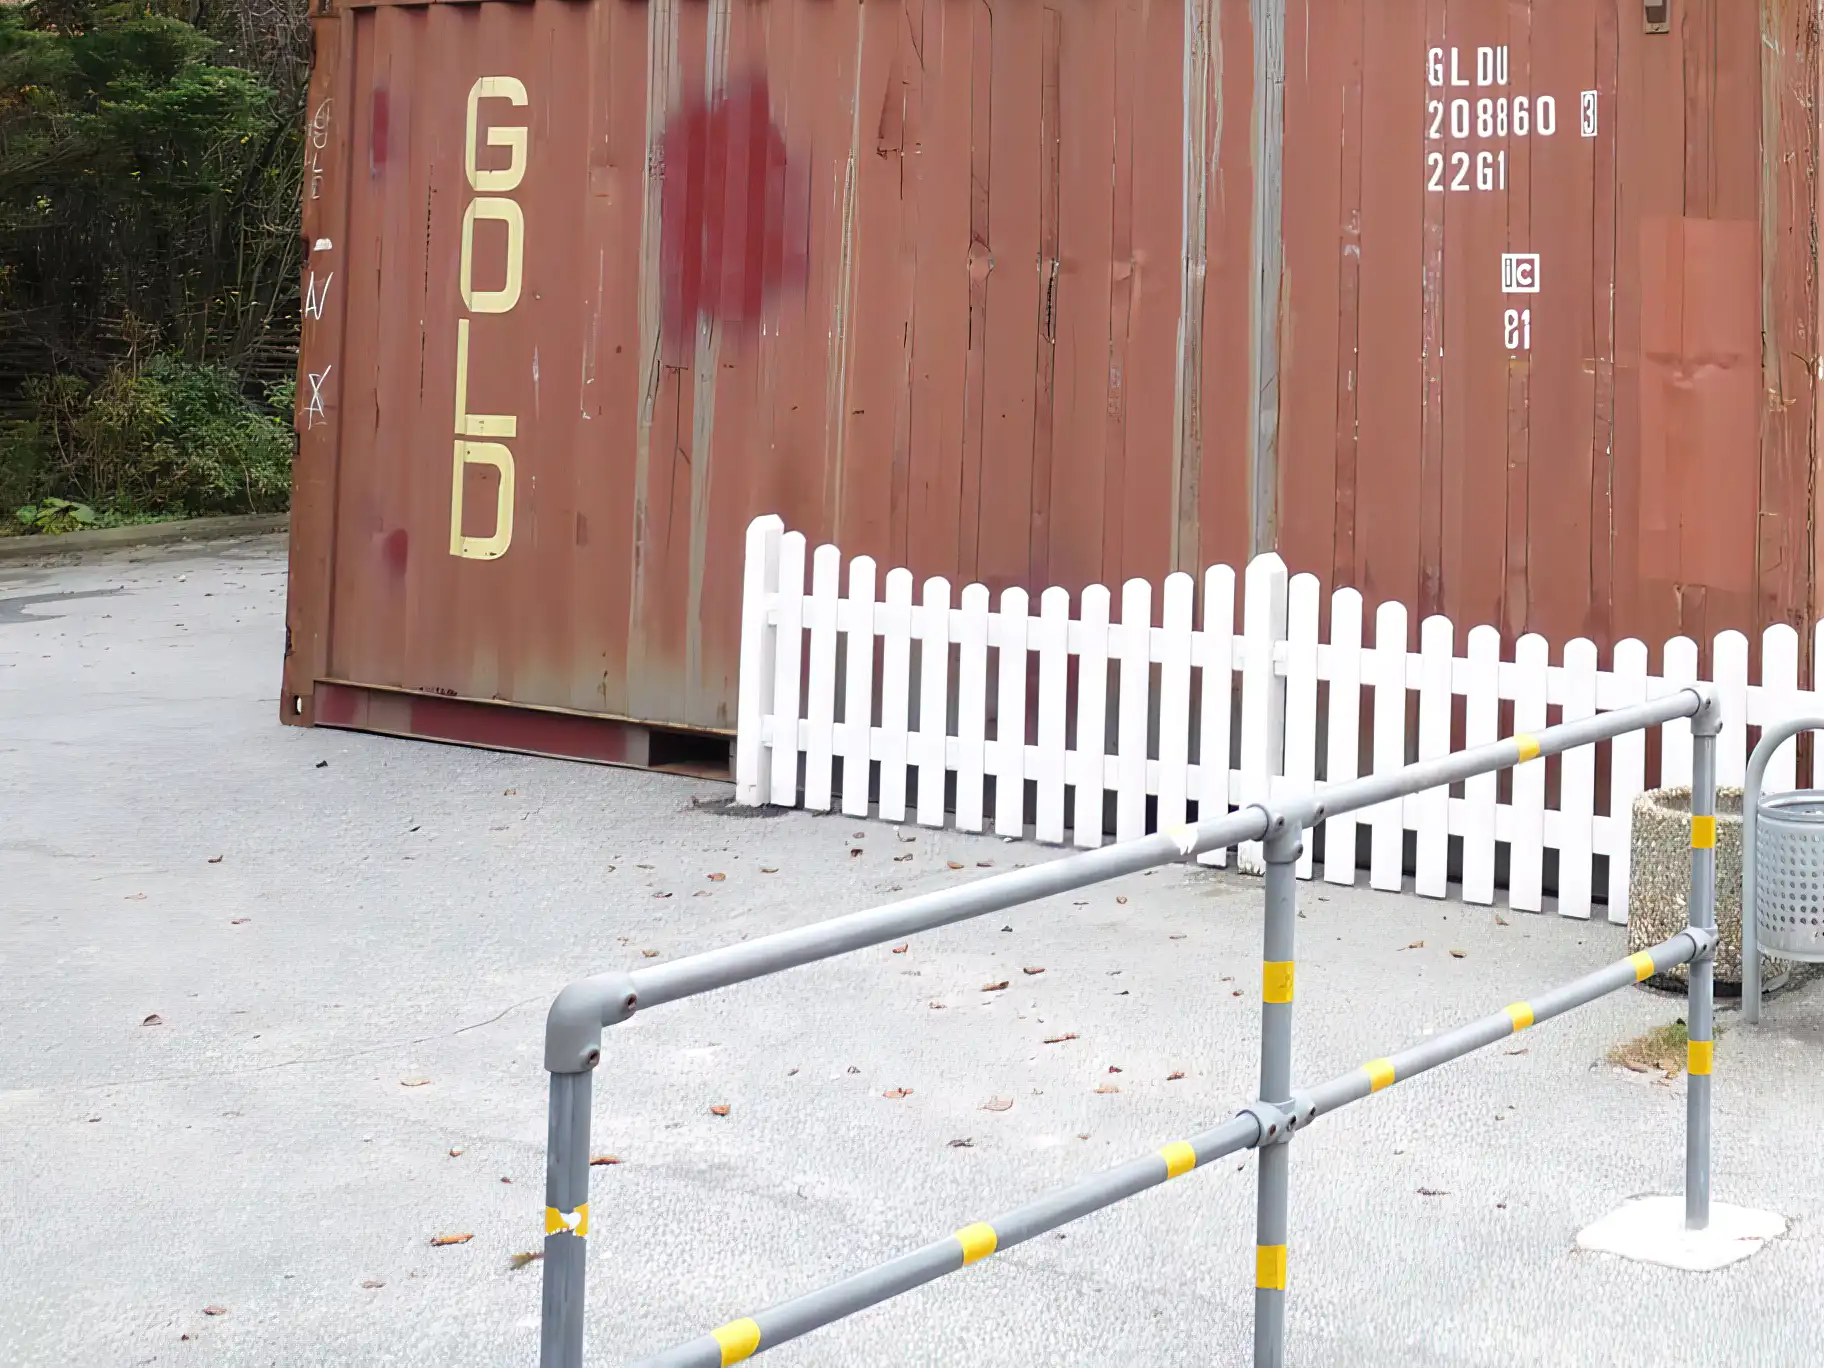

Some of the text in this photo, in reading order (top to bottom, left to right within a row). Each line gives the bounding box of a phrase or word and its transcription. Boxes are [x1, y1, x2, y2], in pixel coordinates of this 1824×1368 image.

[1427, 46, 1508, 86] GLDU
[1427, 93, 1596, 140] 208860 3
[1427, 150, 1506, 192] 22G1
[449, 75, 528, 561] GOLD
